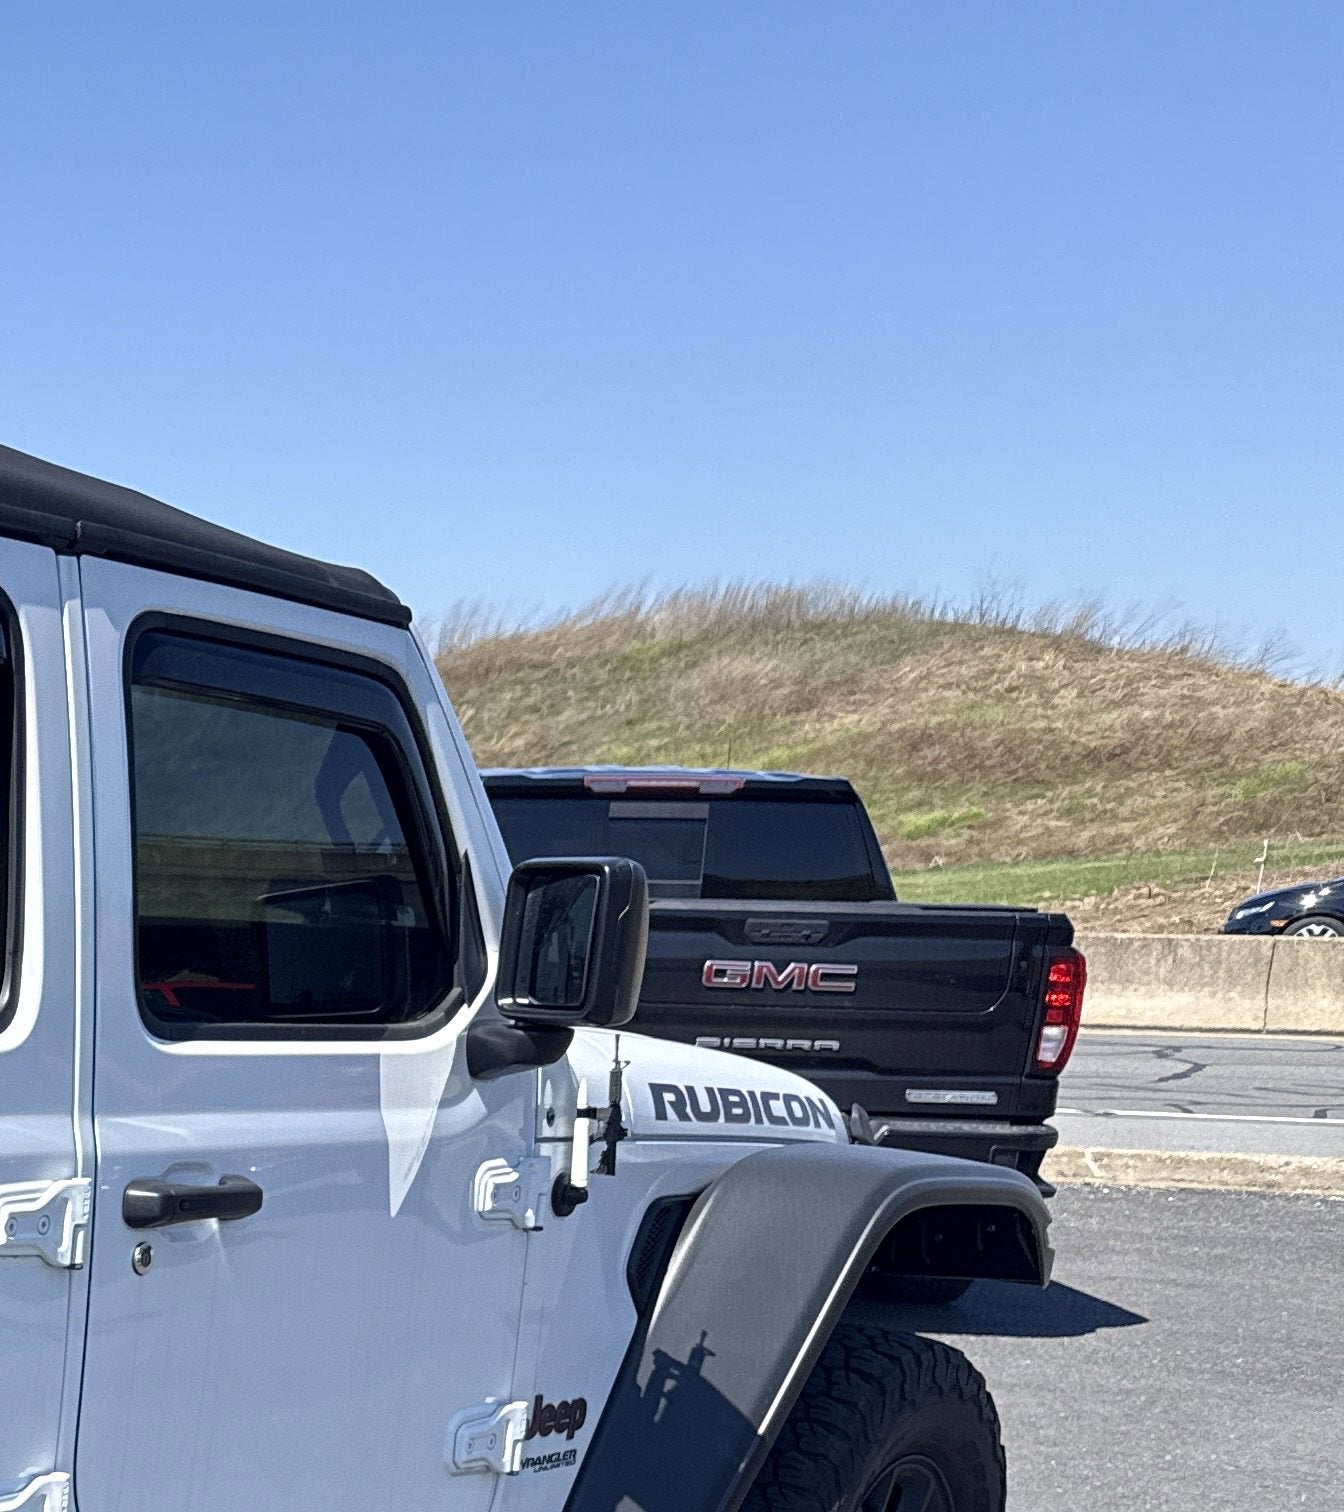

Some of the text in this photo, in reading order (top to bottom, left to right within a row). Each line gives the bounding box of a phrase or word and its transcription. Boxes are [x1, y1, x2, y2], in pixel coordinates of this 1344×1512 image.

[702, 959, 858, 993] GMC
[695, 1036, 840, 1051] SIERRA
[648, 1082, 835, 1130] RUBICON
[524, 1394, 587, 1441] Jeep
